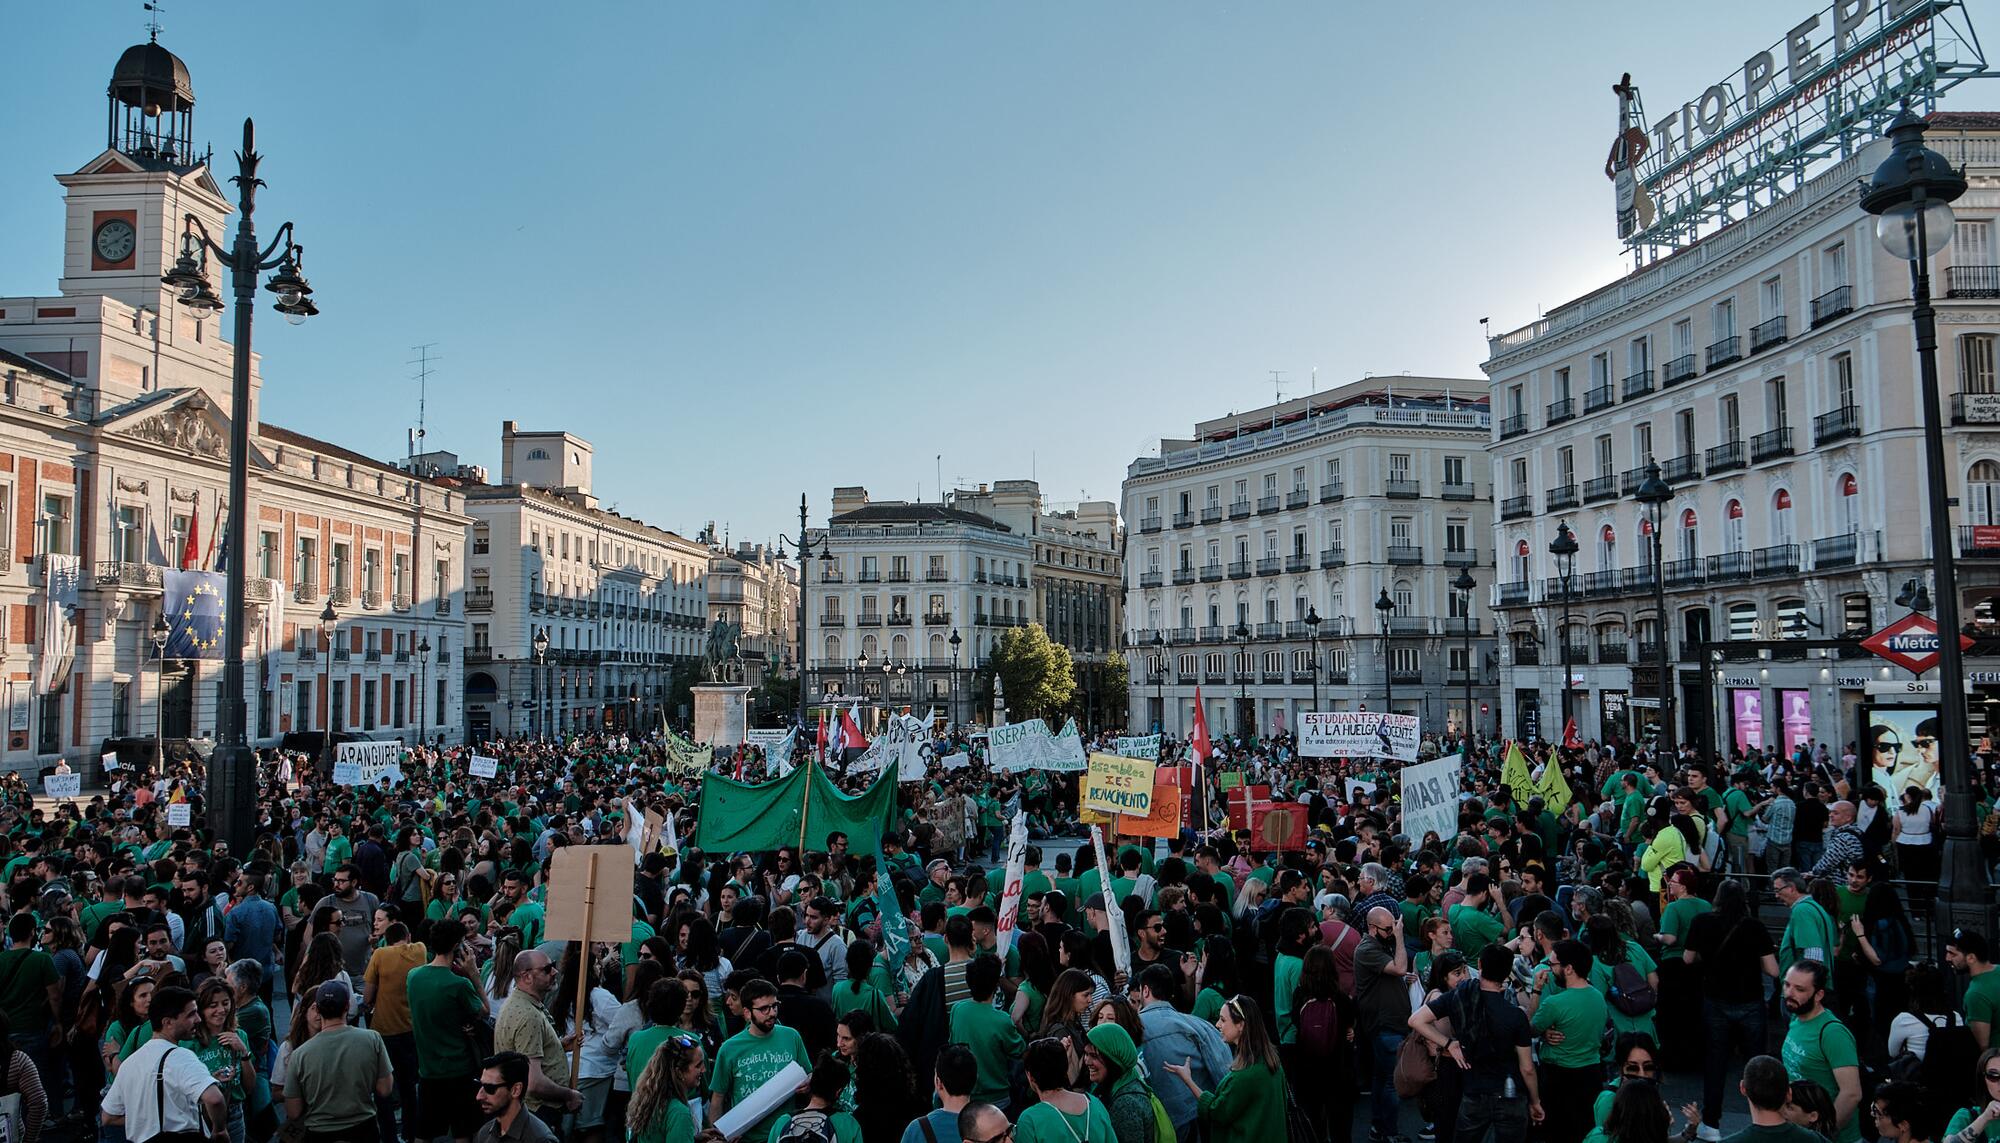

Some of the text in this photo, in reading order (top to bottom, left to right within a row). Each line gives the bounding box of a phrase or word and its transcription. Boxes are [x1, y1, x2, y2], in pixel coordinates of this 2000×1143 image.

[1653, 85, 1727, 165] TIO
[1604, 694, 1624, 702] PRIMA
[1605, 703, 1622, 711] VERA
[1305, 713, 1380, 725] ESTUDIANTES
[1394, 715, 1416, 729] APOYO
[1605, 711, 1614, 720] TE
[1311, 724, 1319, 736] A
[1325, 724, 1341, 736] LA
[1342, 723, 1379, 736] HUELGA
[1118, 738, 1130, 749] IES
[1134, 737, 1151, 747] VILLA
[341, 744, 401, 767] ARANGUREN
[362, 769, 372, 780] LA
[1105, 775, 1132, 788] IES
[738, 1052, 768, 1068] ESCUELA
[745, 1072, 758, 1082] DE
